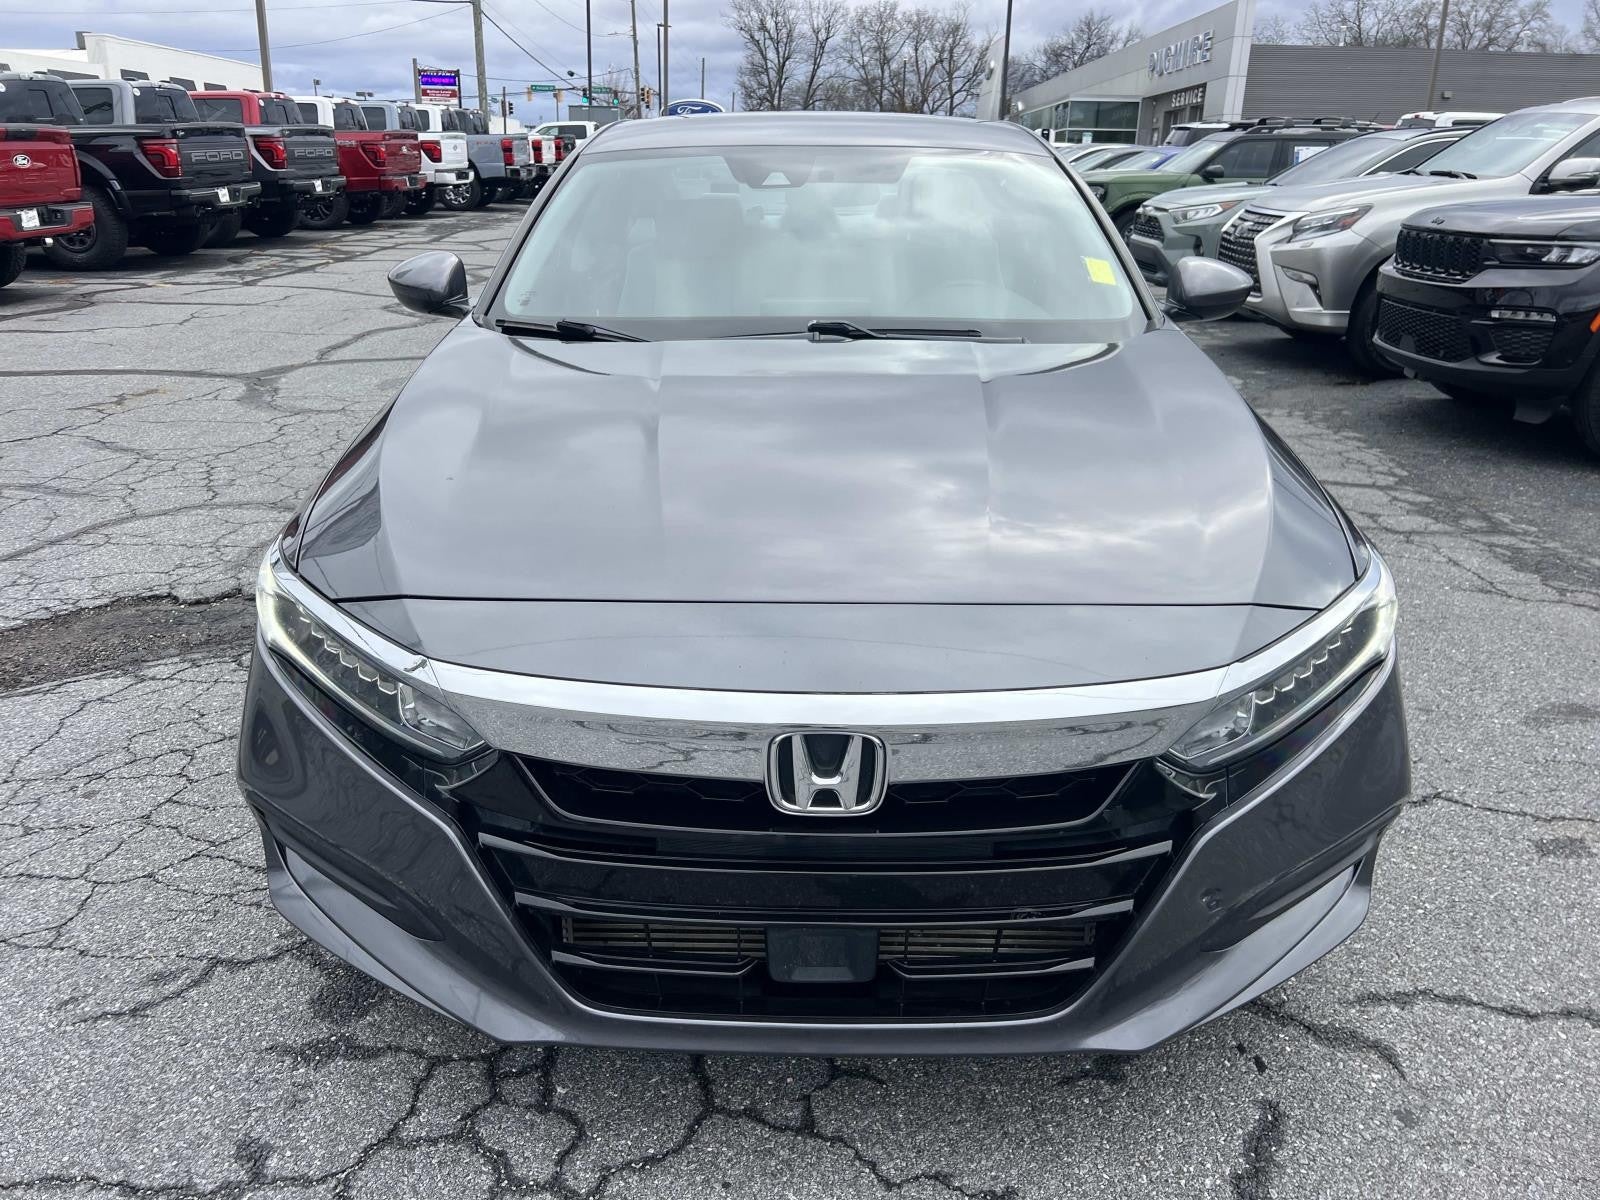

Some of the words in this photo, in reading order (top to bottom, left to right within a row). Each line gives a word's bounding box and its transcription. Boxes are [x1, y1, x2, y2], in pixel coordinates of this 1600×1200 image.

[1148, 29, 1213, 75] PUGMIRE
[1171, 87, 1204, 107] SERVICE
[191, 151, 244, 162] FORD
[294, 149, 333, 157] FORD
